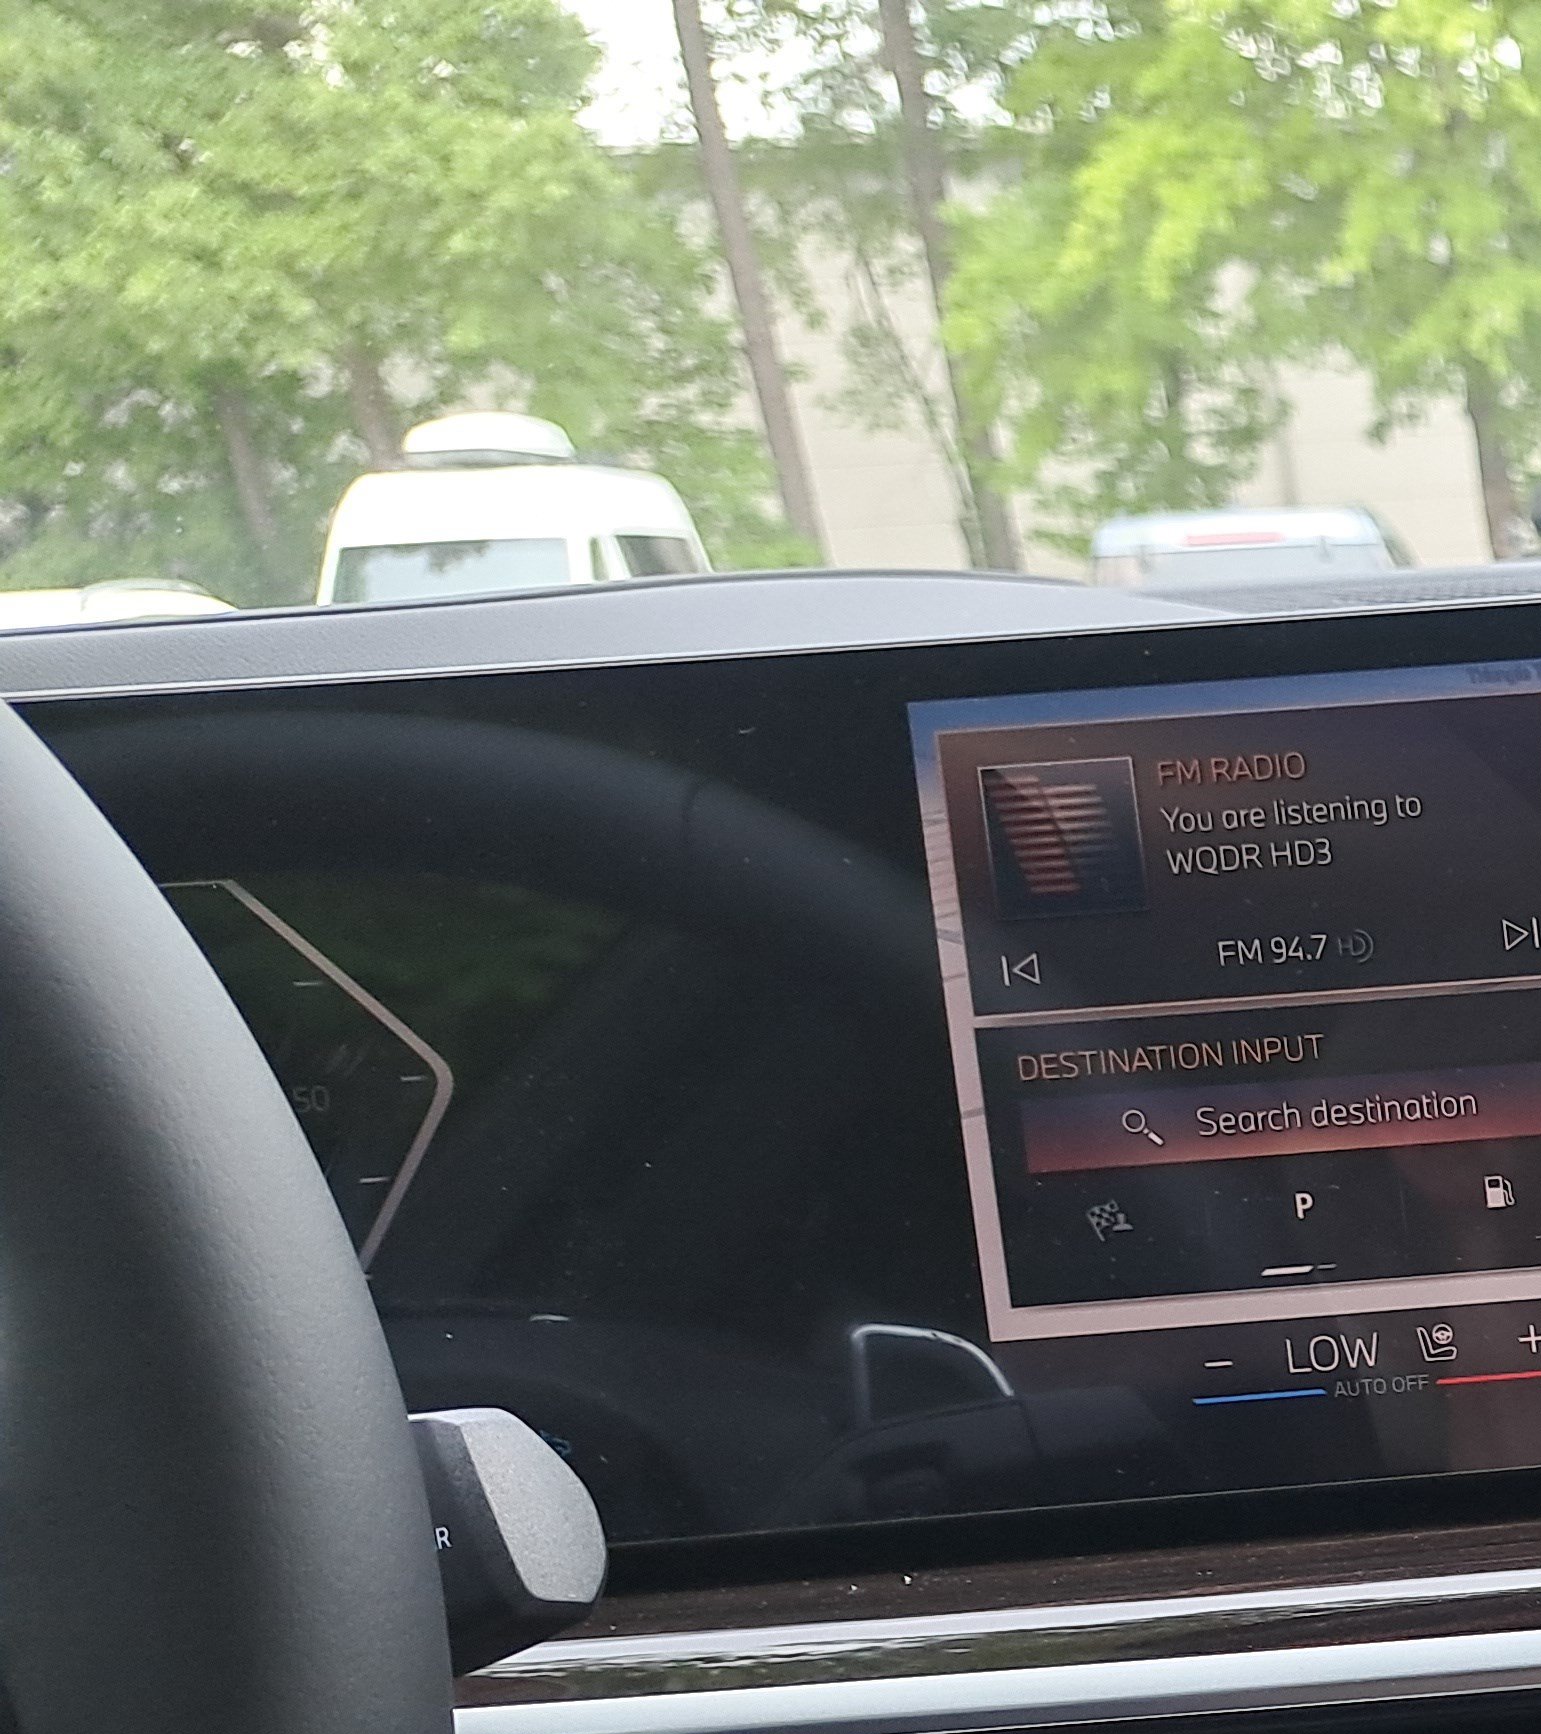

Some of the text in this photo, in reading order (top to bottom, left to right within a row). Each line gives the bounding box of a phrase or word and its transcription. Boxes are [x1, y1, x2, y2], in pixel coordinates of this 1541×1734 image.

[1157, 751, 1306, 785] FM RADIO
[1160, 794, 1422, 833] You are listening to
[1166, 838, 1333, 875] WQDR HD3
[1217, 938, 1263, 966] FM
[1270, 934, 1327, 964] 94.7
[1017, 1033, 1325, 1082] DESTINATION INPUT
[1196, 1090, 1478, 1137] Search destination
[1295, 1193, 1315, 1220] P
[1285, 1332, 1378, 1374] LOW
[1334, 1374, 1430, 1397] AUTO OFF
[435, 1526, 452, 1549] R
